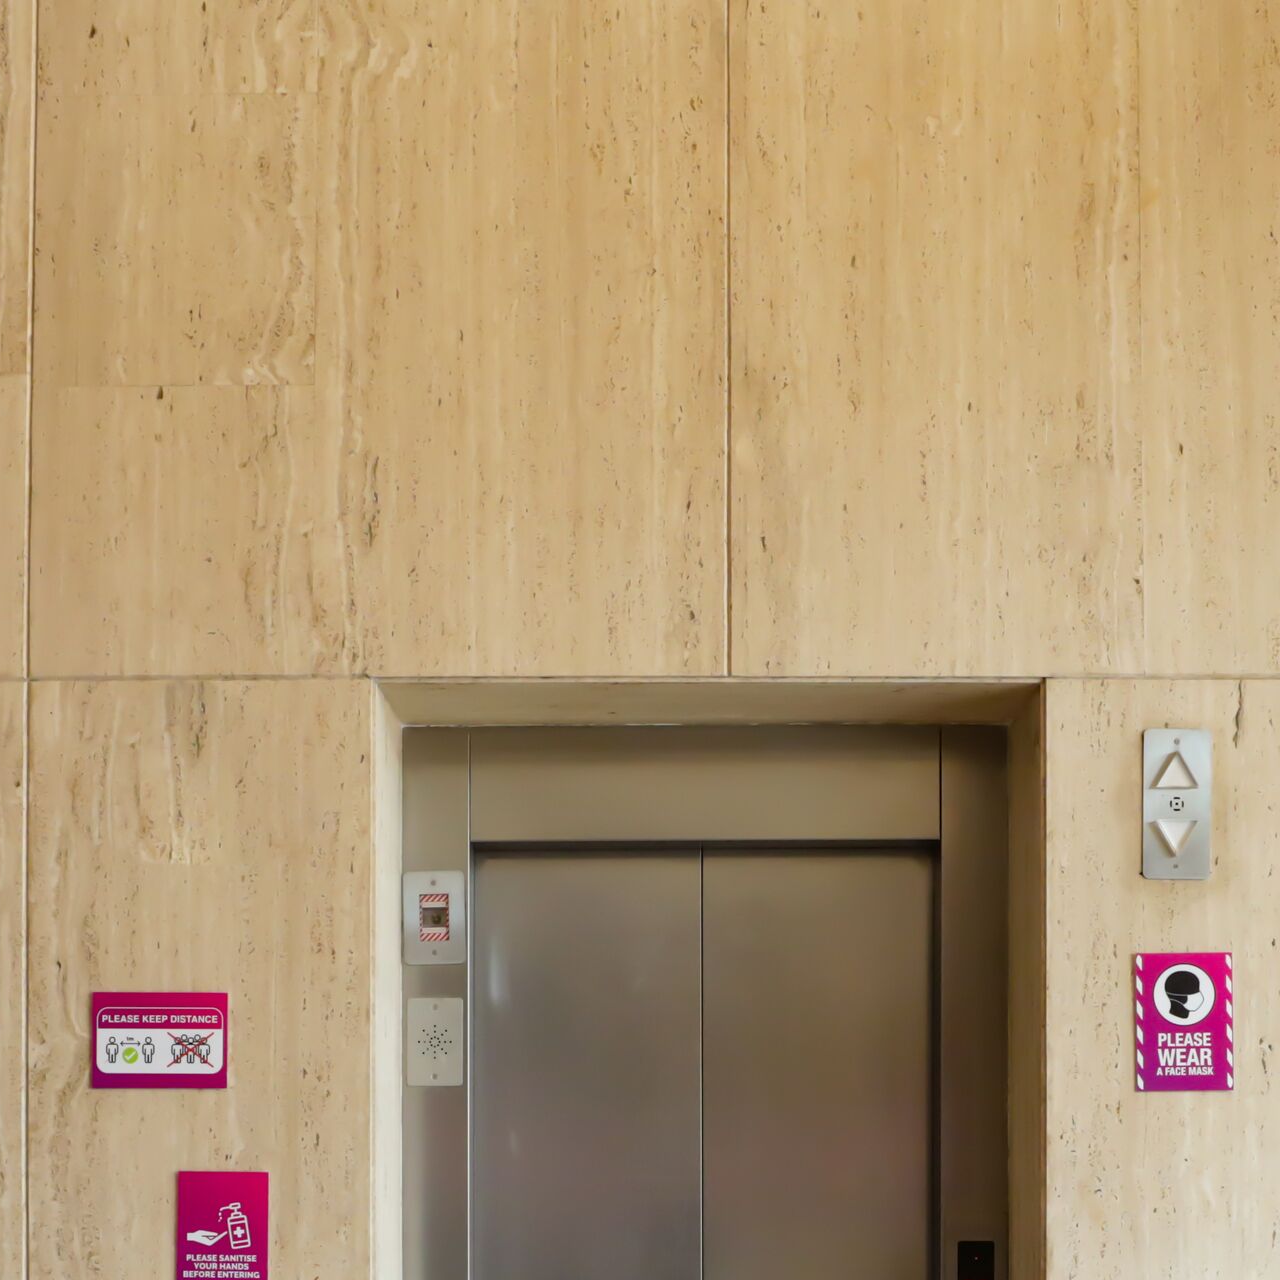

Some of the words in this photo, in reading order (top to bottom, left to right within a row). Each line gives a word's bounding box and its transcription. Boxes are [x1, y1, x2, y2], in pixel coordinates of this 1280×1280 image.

[102, 1014, 140, 1023] PLEASE
[142, 1014, 168, 1023] KEEP
[170, 1014, 218, 1023] DISTANCE
[1157, 1032, 1212, 1047] PLEASE
[1157, 1048, 1214, 1066] WEAR
[1156, 1066, 1163, 1076] A
[1165, 1066, 1188, 1076] FACE
[1189, 1066, 1214, 1076] MASK
[186, 1254, 218, 1262] PLEASE
[219, 1254, 257, 1262] SANITISE
[193, 1262, 218, 1270] YOUR
[219, 1262, 250, 1270] HANDS
[182, 1270, 216, 1278] BEFORE
[217, 1270, 260, 1279] ENTERING
